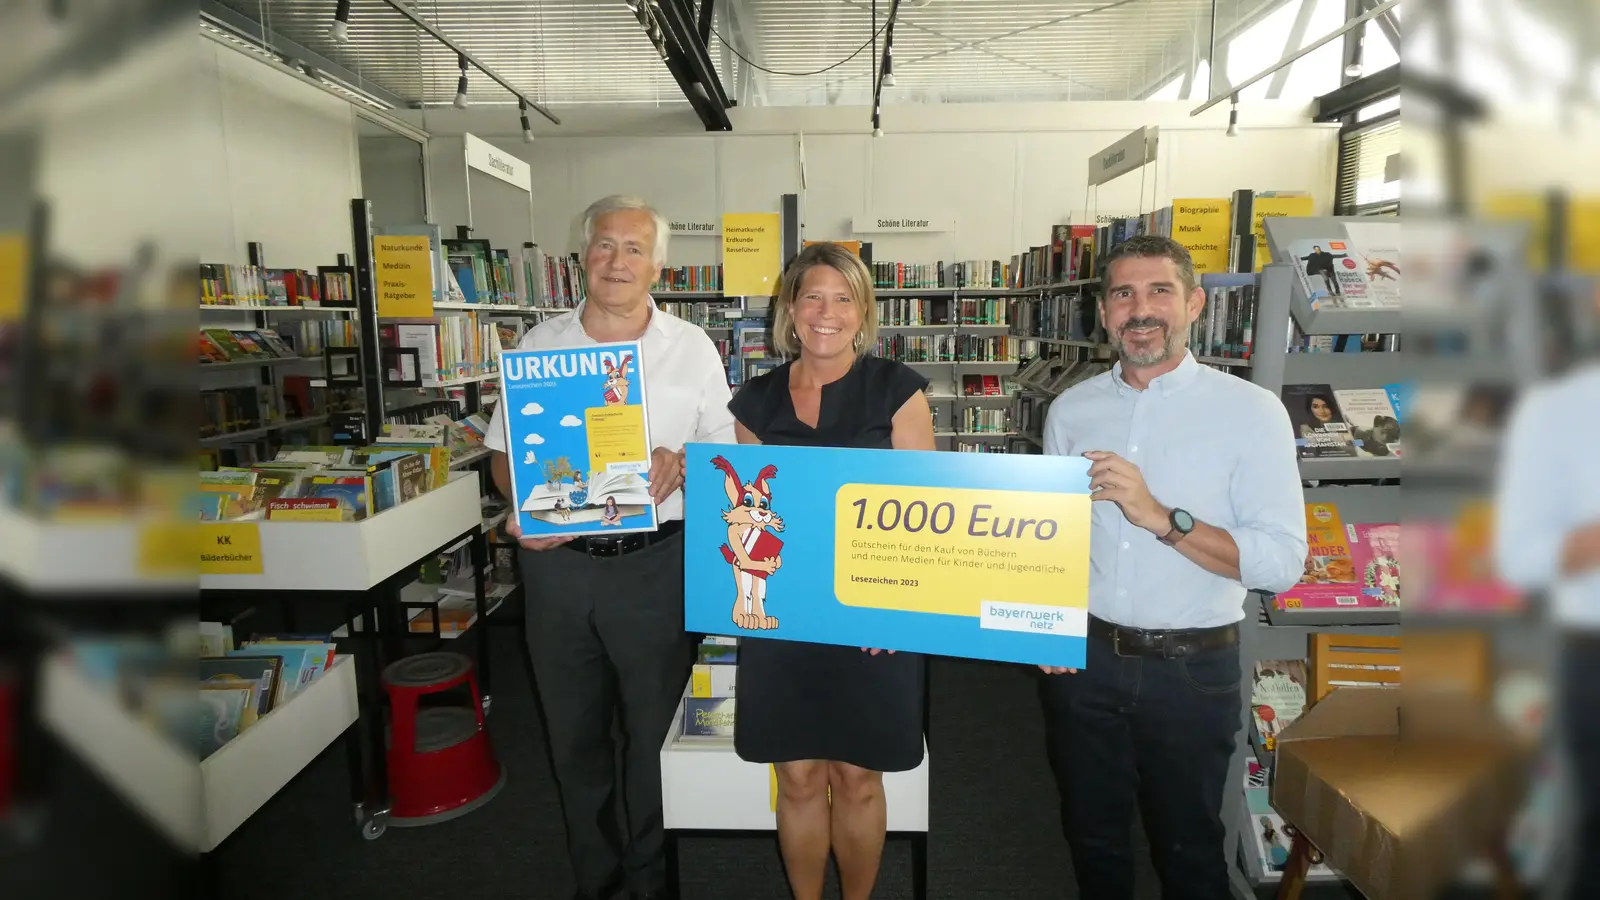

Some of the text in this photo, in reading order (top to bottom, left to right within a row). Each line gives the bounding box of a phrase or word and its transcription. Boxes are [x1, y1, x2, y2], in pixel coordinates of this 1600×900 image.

[1179, 206, 1220, 215] Biographie
[687, 222, 715, 231] Literatur
[877, 218, 929, 228] Schöne Literatur
[1181, 244, 1218, 252] eschichte
[382, 262, 412, 270] Medizin
[384, 292, 416, 300] Ratgeber
[506, 350, 634, 381] URKUNDE
[270, 502, 330, 510] Fisch schwimmt
[852, 498, 1058, 541] 1.000 Euro
[216, 535, 232, 545] KK
[851, 540, 897, 550] Gutschein
[899, 542, 912, 552] für
[914, 544, 932, 552] den
[934, 545, 955, 554] Kauf
[977, 548, 1017, 558] Büchern
[1311, 546, 1346, 556] NDER
[851, 552, 868, 560] und
[900, 555, 935, 565] Medien
[938, 556, 950, 566] für
[953, 558, 984, 568] Kinder
[986, 561, 1005, 570] und
[1007, 562, 1066, 574] Jugendliche
[850, 574, 919, 587] Lesezeichen 2023
[990, 606, 1064, 622] bayernwerk
[1030, 620, 1054, 630] netz
